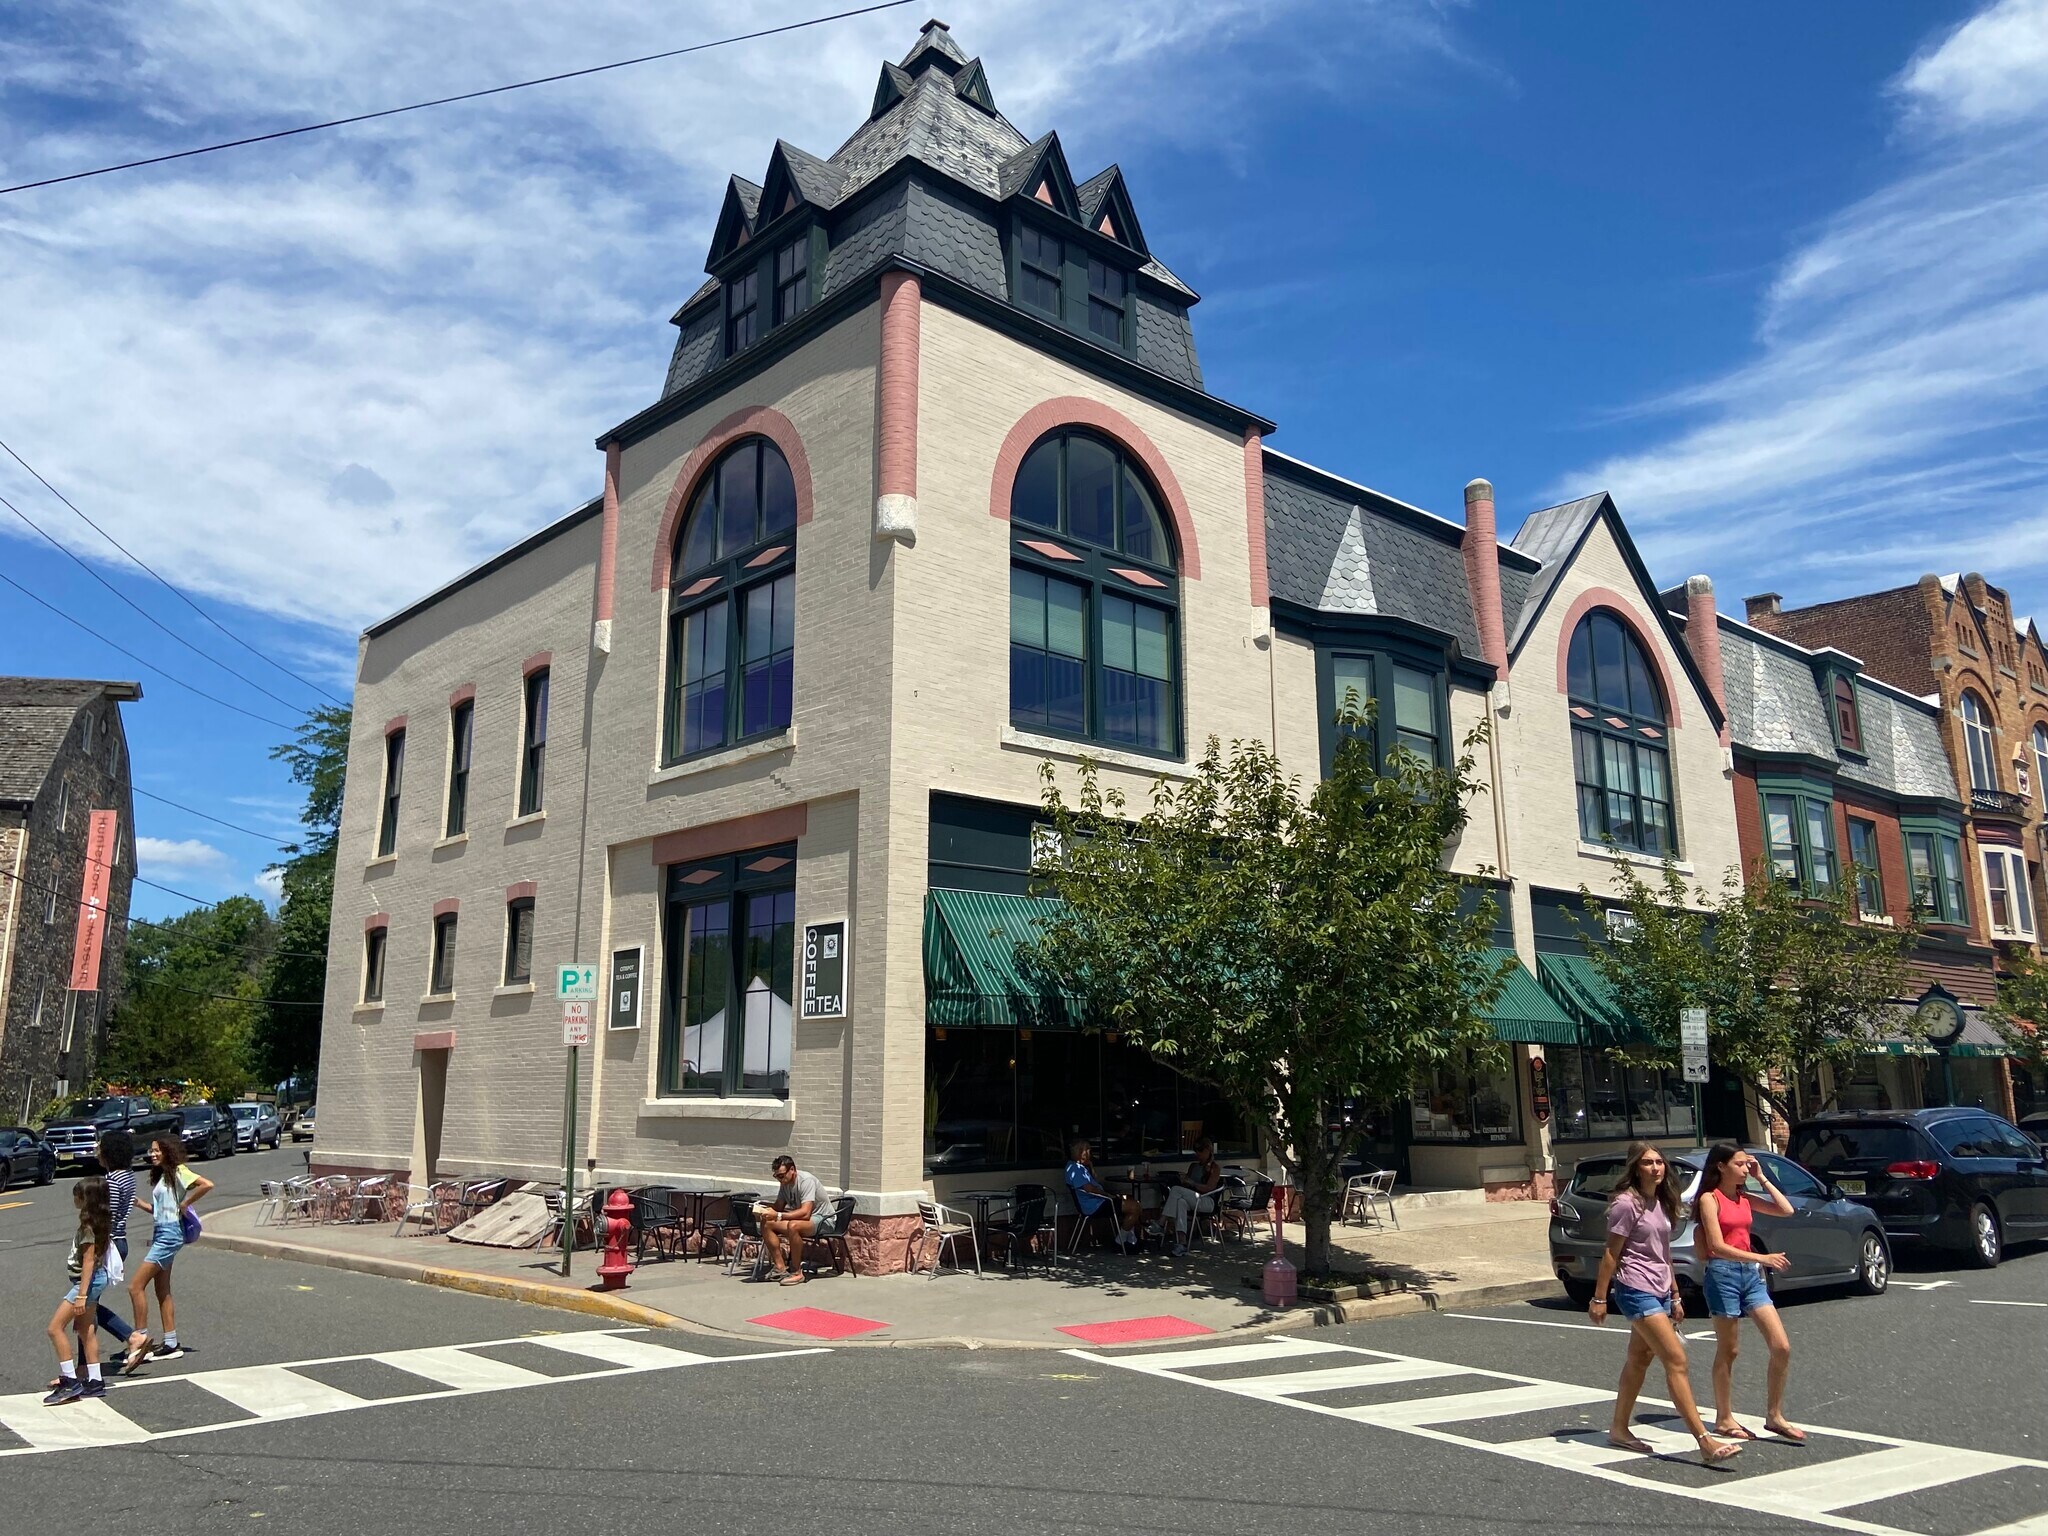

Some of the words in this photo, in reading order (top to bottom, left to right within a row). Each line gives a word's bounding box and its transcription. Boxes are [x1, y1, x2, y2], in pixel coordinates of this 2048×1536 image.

[92, 817, 107, 891] Hunterdon
[87, 896, 100, 922] Art
[80, 926, 95, 983] Museum
[805, 928, 817, 1013] COFFEE
[571, 1005, 582, 1014] NO
[816, 995, 841, 1013] TEA
[565, 1016, 587, 1024] PARKING
[1682, 1011, 1689, 1020] 2
